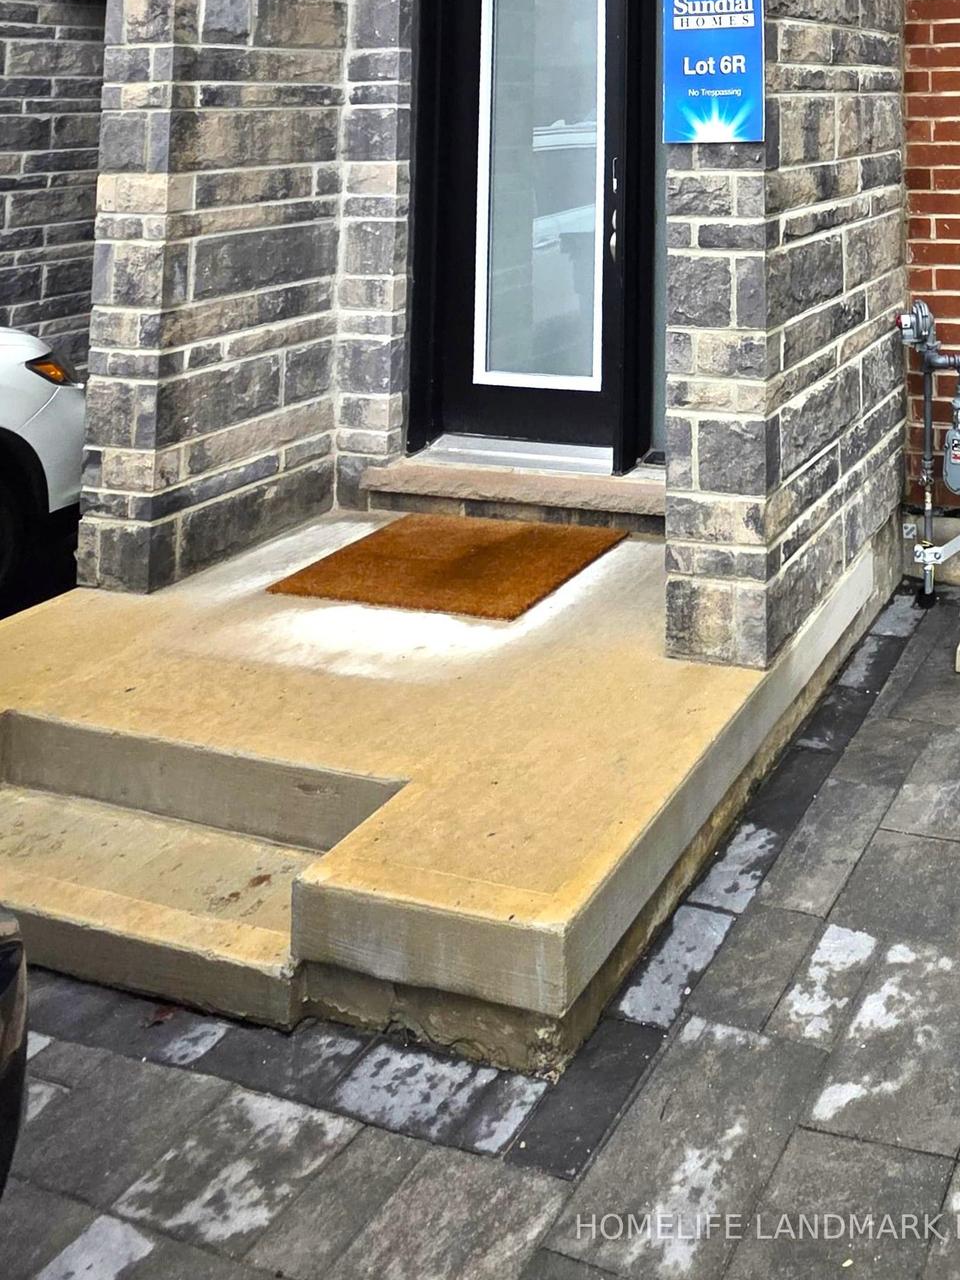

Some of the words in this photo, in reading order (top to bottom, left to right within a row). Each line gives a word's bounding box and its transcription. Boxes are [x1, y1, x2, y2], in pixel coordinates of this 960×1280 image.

[680, 16, 749, 28] HOMES
[684, 56, 716, 75] Lot
[720, 55, 746, 74] 6R
[701, 88, 742, 97] Trespassing
